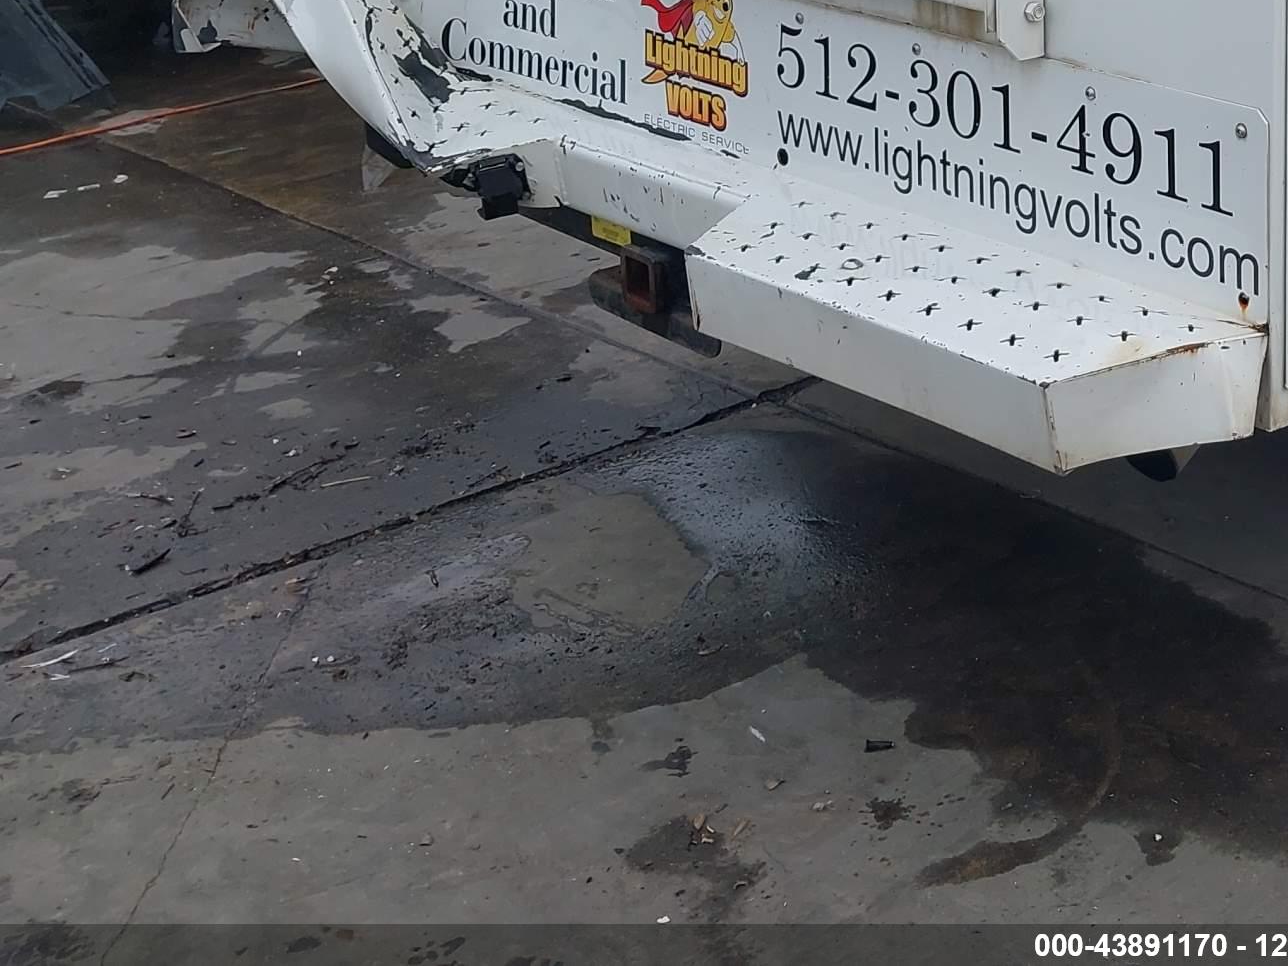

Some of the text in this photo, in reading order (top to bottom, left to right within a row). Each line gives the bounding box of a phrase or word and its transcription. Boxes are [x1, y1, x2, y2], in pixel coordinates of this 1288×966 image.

[441, 17, 629, 105] Commercial
[644, 28, 749, 98] Lightning
[643, 113, 750, 155] ELECTRIC SERVICE
[665, 80, 727, 131] VOLTS
[775, 22, 1234, 218] 512-301-4911
[777, 109, 1260, 297] www.lightningvolts.com
